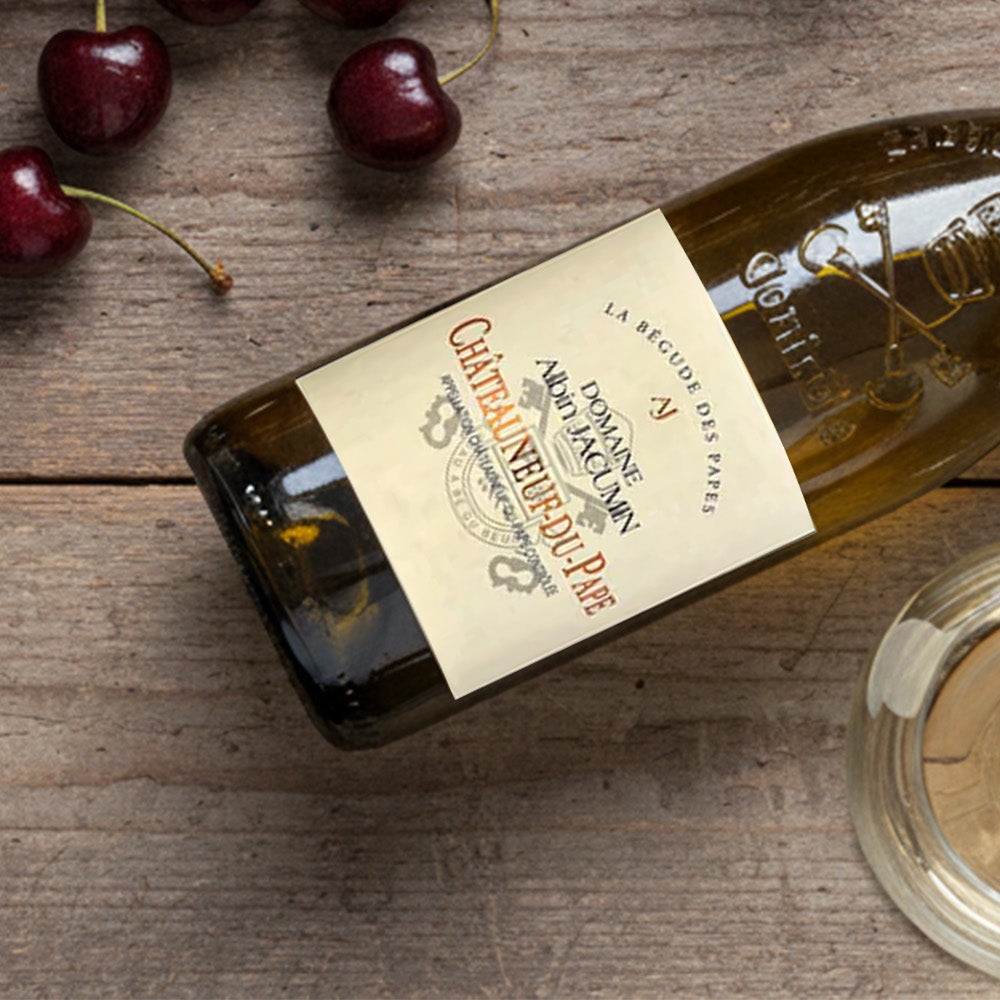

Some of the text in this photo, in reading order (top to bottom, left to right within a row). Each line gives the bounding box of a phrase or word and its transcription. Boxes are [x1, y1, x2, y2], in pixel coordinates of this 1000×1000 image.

[536, 358, 641, 536] Albin JACUMIN
[581, 380, 644, 487] DOMAINE
[604, 302, 721, 515] LA BÉGUDE DES PAPES
[650, 396, 678, 420] AJ
